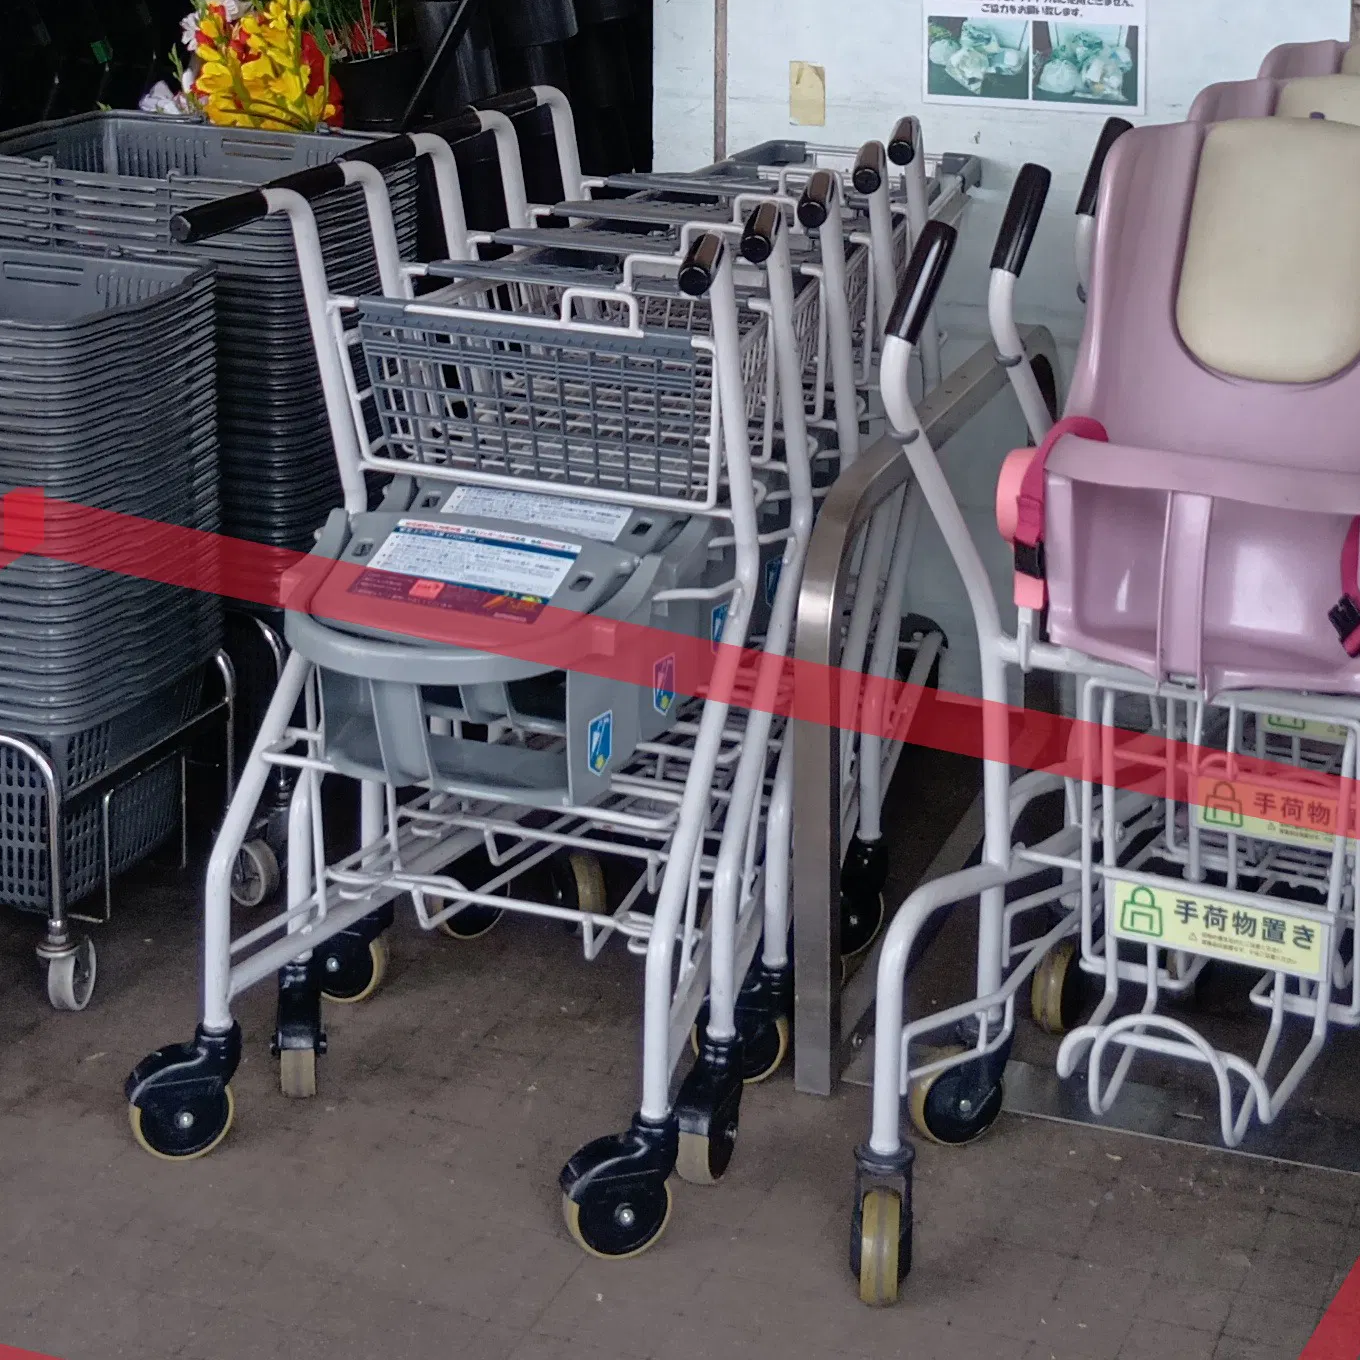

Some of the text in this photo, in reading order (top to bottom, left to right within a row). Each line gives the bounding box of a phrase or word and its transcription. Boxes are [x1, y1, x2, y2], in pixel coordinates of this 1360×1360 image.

[1173, 897, 1315, 952] 手荷物置き
